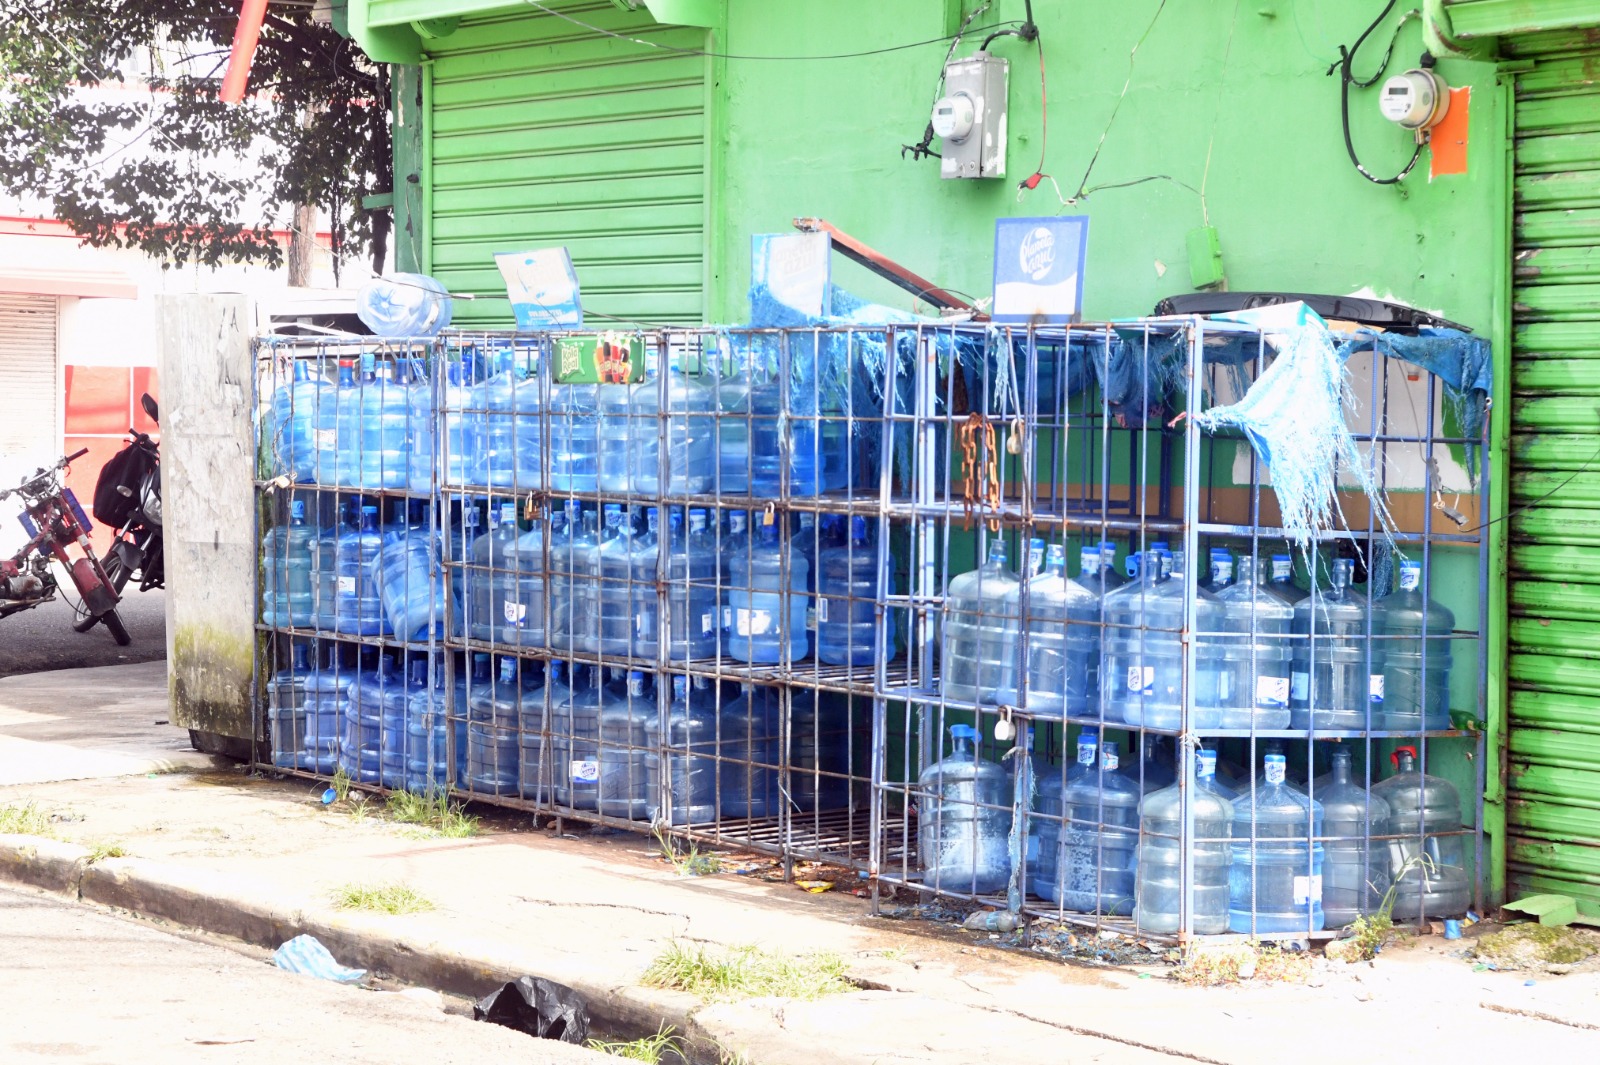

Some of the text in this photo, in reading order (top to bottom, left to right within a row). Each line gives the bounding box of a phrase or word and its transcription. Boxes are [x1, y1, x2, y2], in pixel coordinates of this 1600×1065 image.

[1021, 234, 1054, 262] Planeta
[562, 347, 578, 360] Kola
[562, 359, 578, 374] Real
